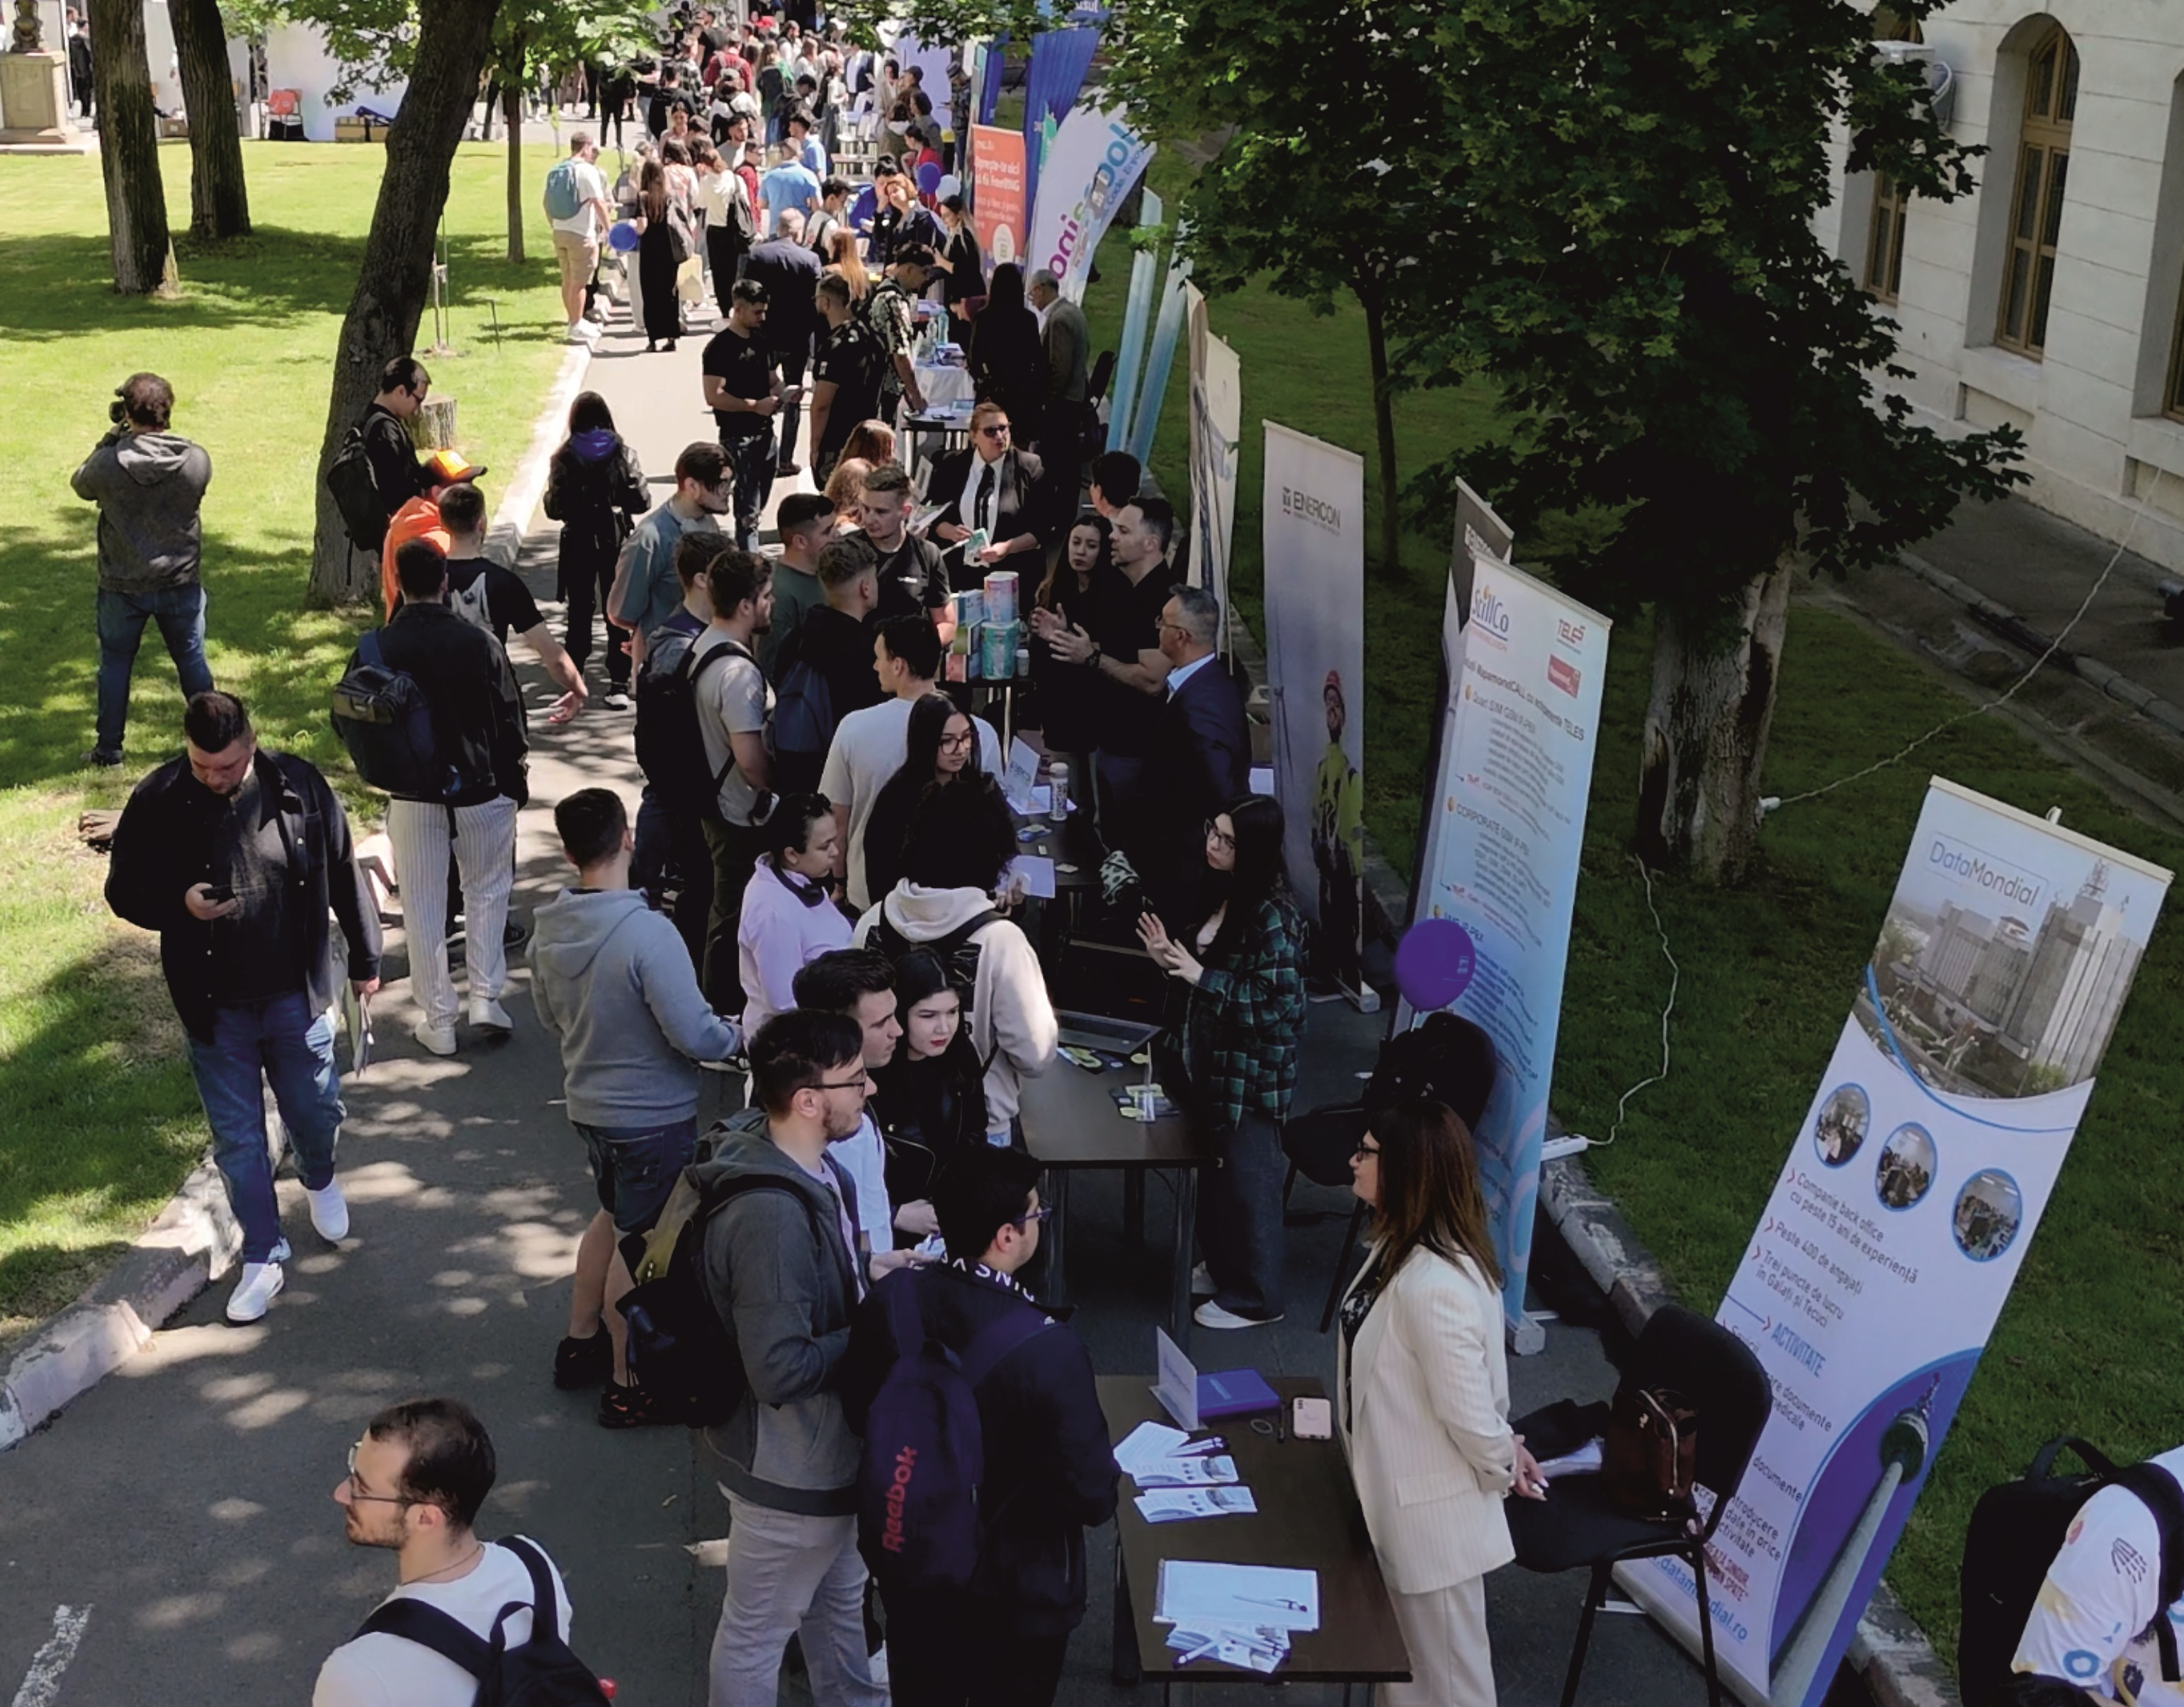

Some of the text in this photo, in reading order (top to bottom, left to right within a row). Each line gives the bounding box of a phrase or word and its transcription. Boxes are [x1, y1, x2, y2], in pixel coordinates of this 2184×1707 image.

[1293, 491, 1340, 529] ENERCON
[1929, 841, 2040, 907] DataMondial
[1789, 1191, 1801, 1206] cu
[1800, 1197, 1826, 1223] peste
[1826, 1213, 1838, 1230] 15
[1836, 1221, 1851, 1239] ani
[1850, 1230, 1862, 1247] de
[1797, 1172, 1884, 1242] Companie back office
[1775, 1221, 1801, 1247] Peste
[1801, 1238, 1818, 1260] 400
[1817, 1252, 1829, 1269] de
[1763, 1249, 1845, 1320] Trei puncte de lucru
[1804, 1299, 1829, 1328] Tecuci
[1770, 1322, 1826, 1378] ACTIVITATE
[1782, 1387, 1833, 1431] documente
[882, 1444, 918, 1553] Reebok
[1752, 1455, 1802, 1503] documente
[1724, 1506, 1745, 1531] date
[1756, 1531, 1782, 1561] orice
